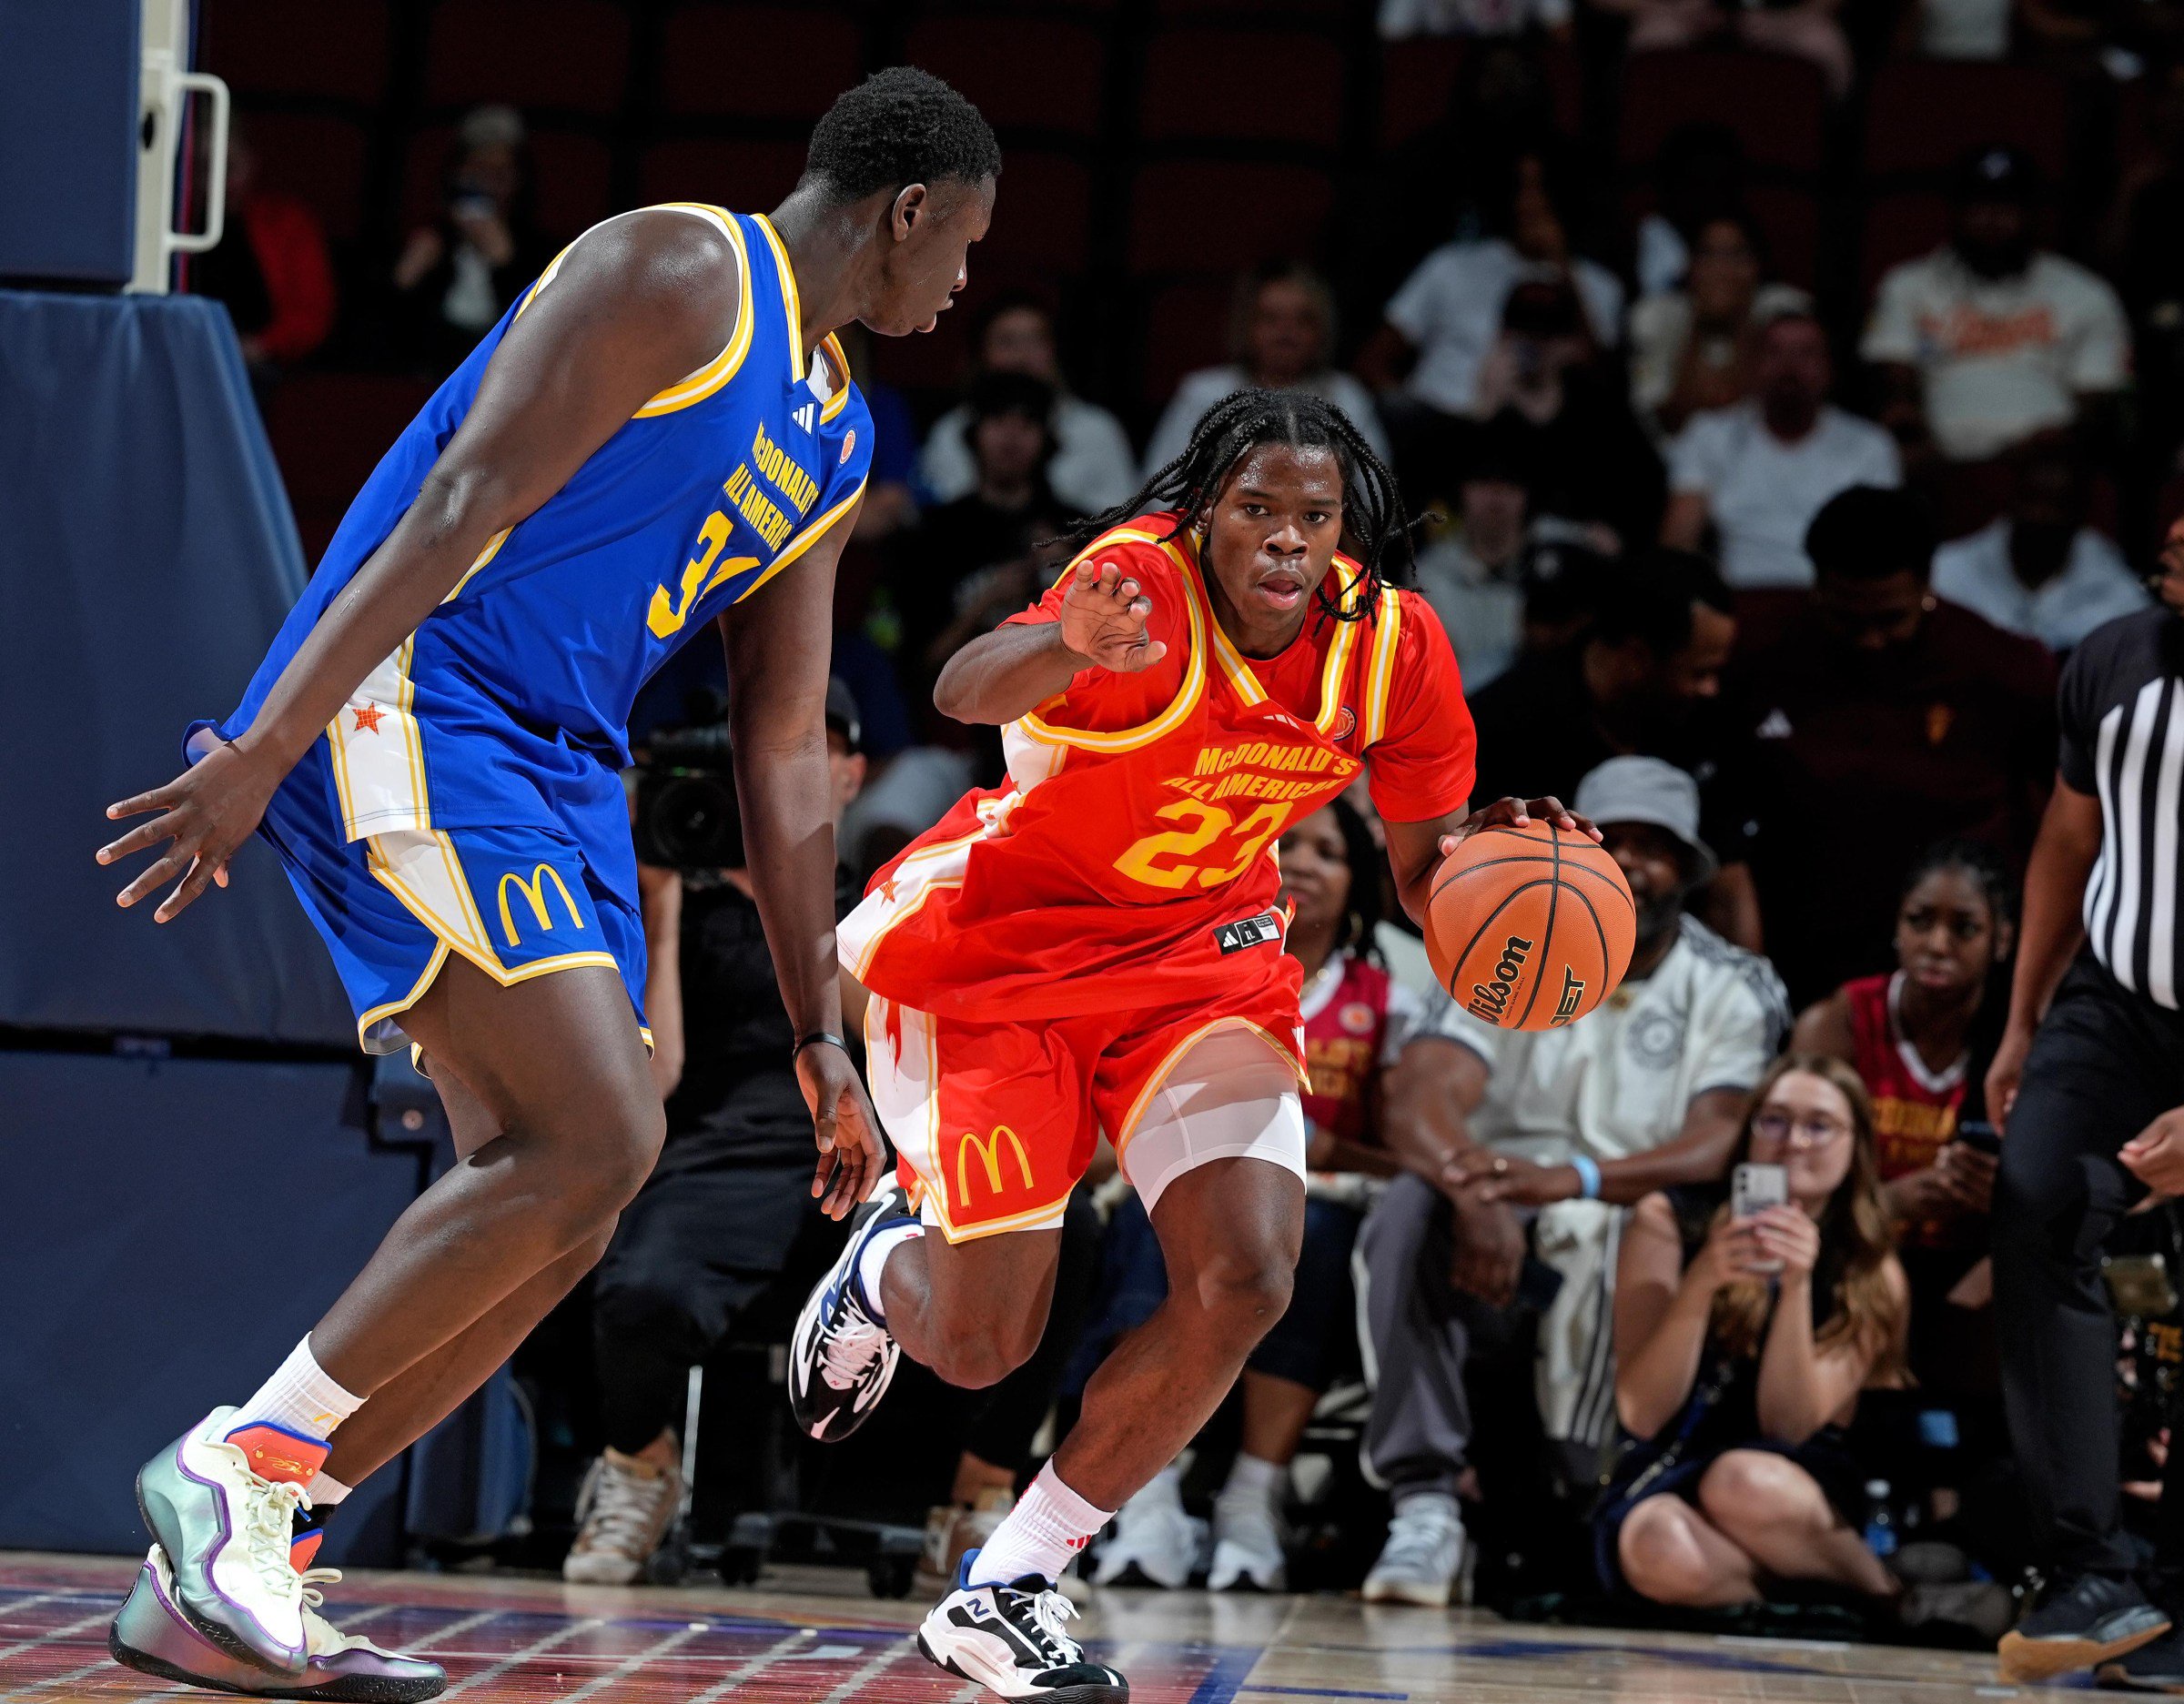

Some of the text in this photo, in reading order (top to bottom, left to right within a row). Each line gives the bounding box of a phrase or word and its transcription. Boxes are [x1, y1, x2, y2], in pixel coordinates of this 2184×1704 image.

[723, 462, 793, 552] ALL AMERIC
[1160, 777, 1214, 800] ALL
[1193, 741, 1359, 776] McDONALD'S
[1112, 798, 1293, 889] 23
